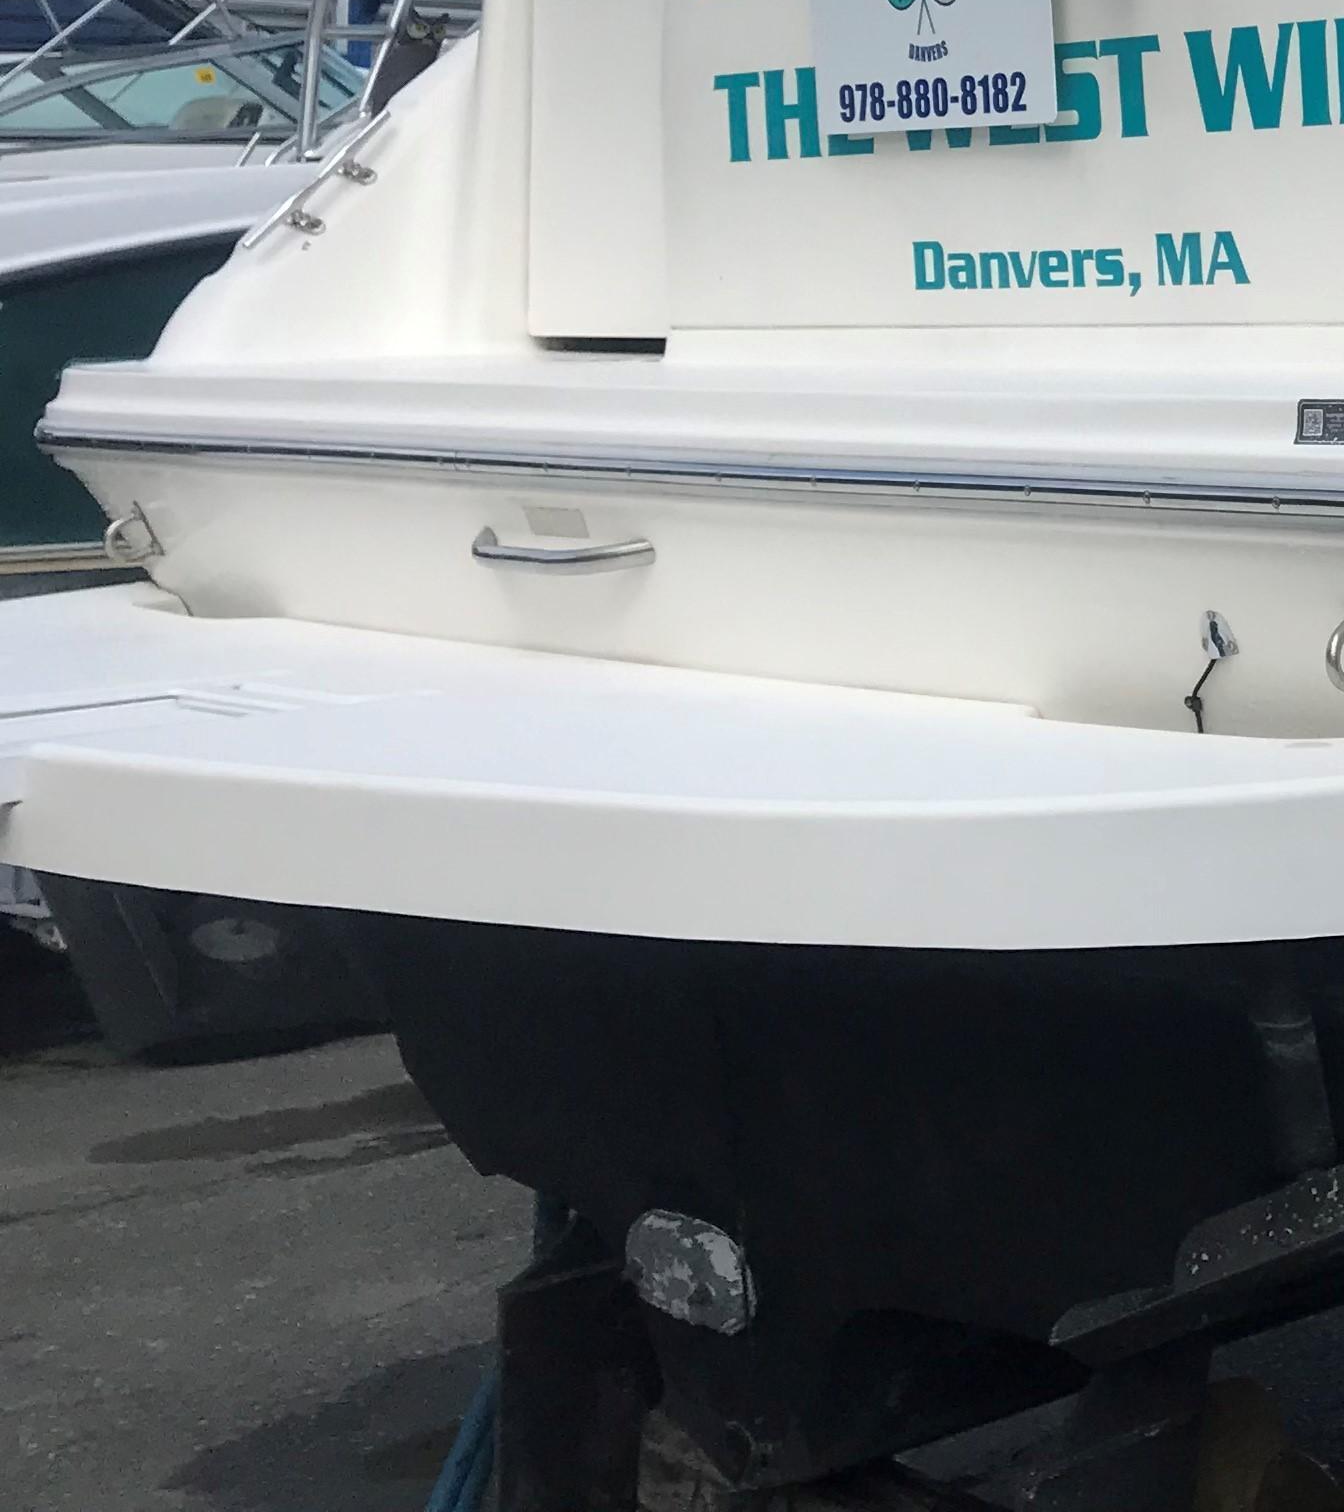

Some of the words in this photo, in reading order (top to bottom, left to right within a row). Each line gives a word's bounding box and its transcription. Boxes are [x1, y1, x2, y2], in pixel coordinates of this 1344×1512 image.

[908, 40, 949, 62] DANVERS
[713, 66, 874, 162] TH
[839, 71, 1027, 123] 978-880-8182
[912, 240, 1142, 296] Danvers,
[1155, 231, 1251, 285] MA
